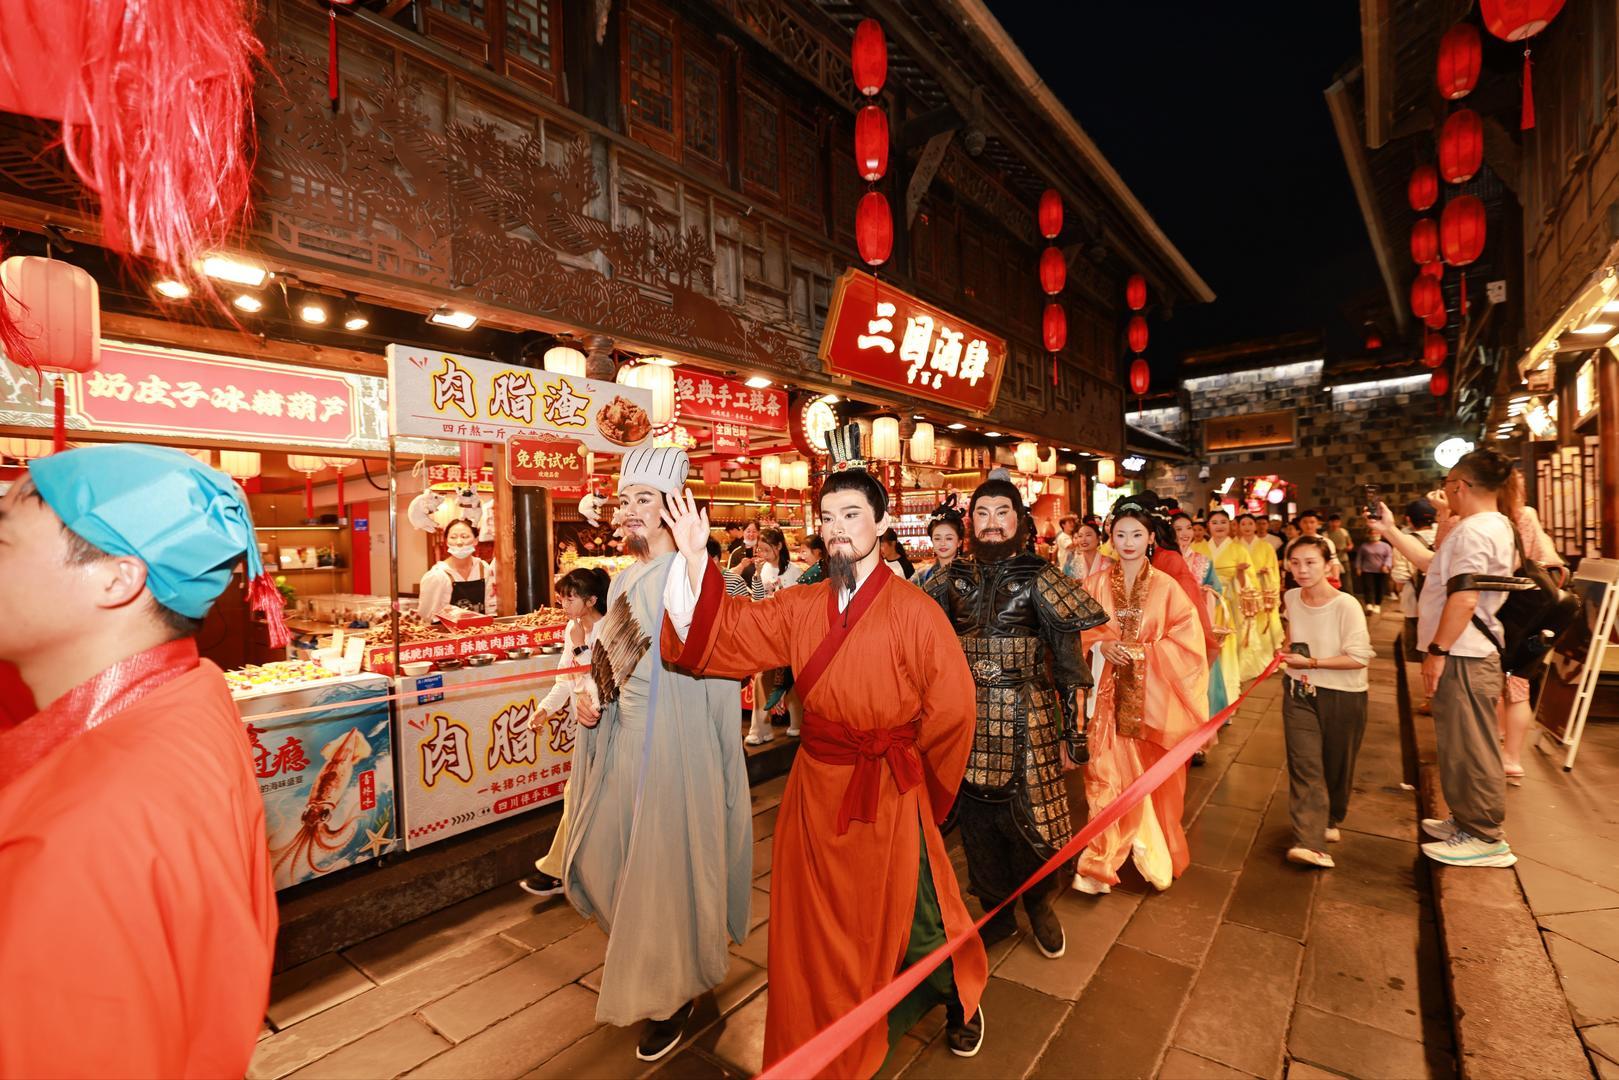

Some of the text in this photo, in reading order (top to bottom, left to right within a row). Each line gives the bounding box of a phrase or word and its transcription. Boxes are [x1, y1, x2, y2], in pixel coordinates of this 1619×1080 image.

[86, 370, 348, 422] 奶皮子冰糖葫芦
[432, 357, 591, 427] 肉脂渣
[677, 375, 781, 417] 经典手工辣条
[442, 424, 507, 440] 四斤熬一斤
[515, 448, 579, 471] 免费试吃
[460, 633, 529, 655] 酥脆肉脂渣
